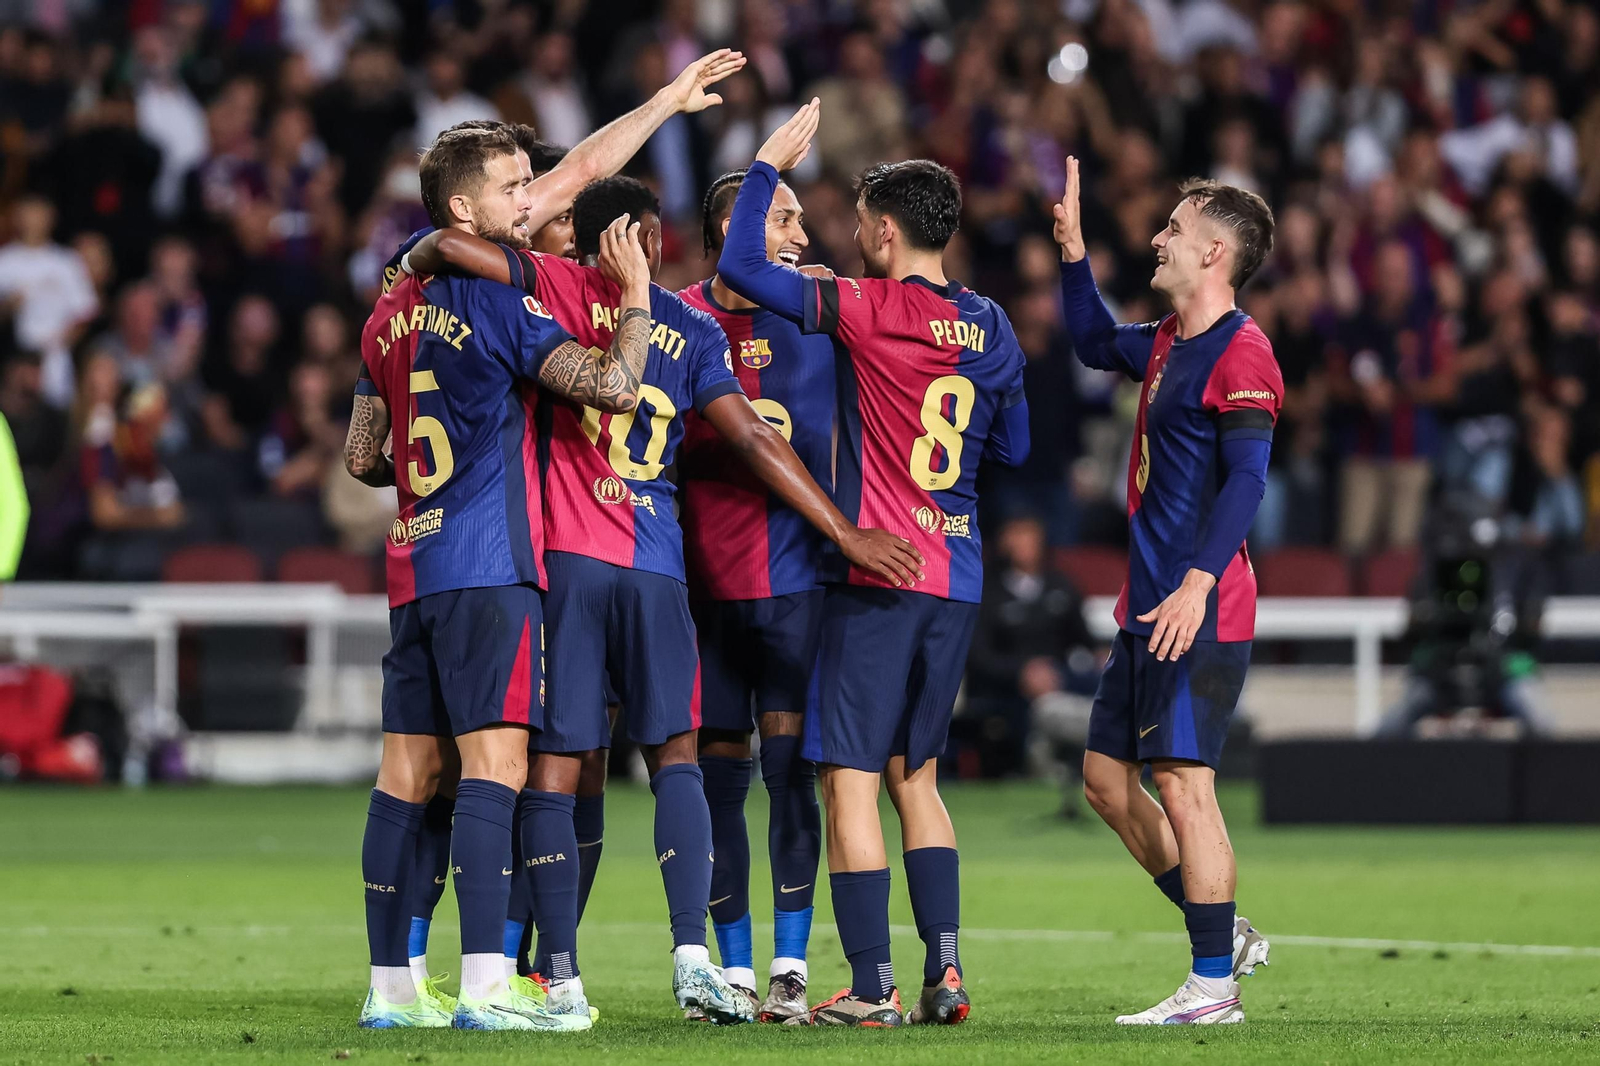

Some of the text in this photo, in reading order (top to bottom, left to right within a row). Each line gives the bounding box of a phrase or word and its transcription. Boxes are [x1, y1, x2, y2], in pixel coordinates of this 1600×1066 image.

[390, 304, 473, 352] MRTINEZ
[928, 319, 986, 353] PEDRI
[1226, 390, 1270, 402] AMBILIGHT
[408, 369, 455, 498] 5
[909, 374, 976, 491] 8
[408, 508, 444, 527] UNHCR
[408, 518, 442, 538] ACNUR
